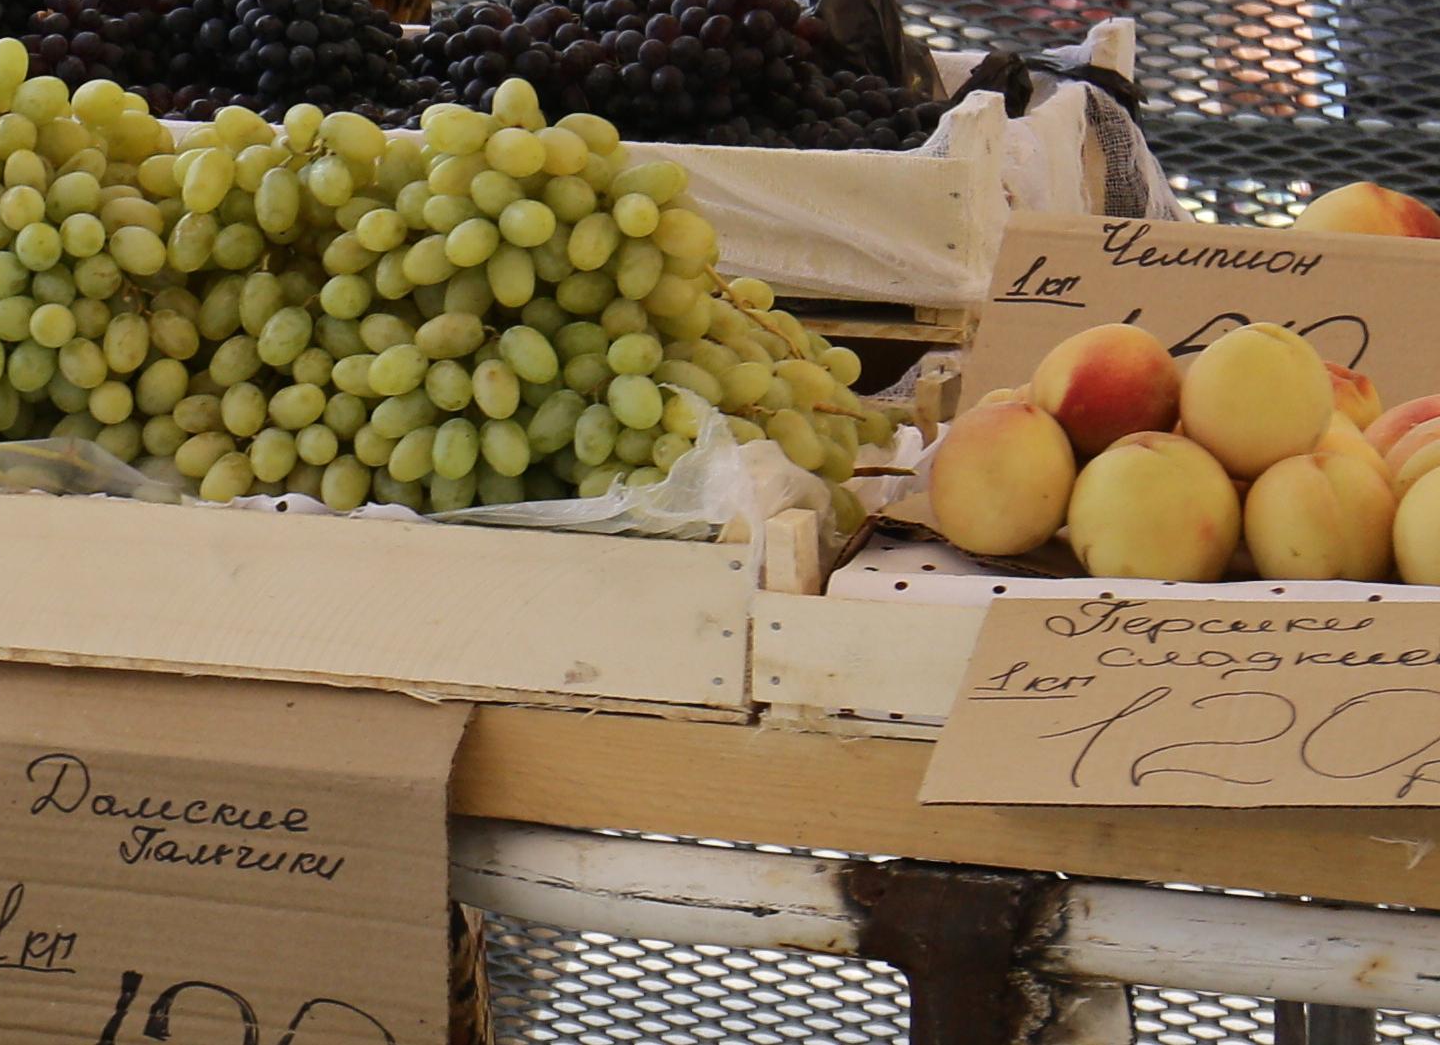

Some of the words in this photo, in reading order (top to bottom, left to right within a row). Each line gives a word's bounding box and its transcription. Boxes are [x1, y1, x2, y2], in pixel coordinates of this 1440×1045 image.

[1103, 220, 1323, 276] Чемпион
[1045, 600, 1374, 643] Персики
[26, 752, 310, 833] Дамские
